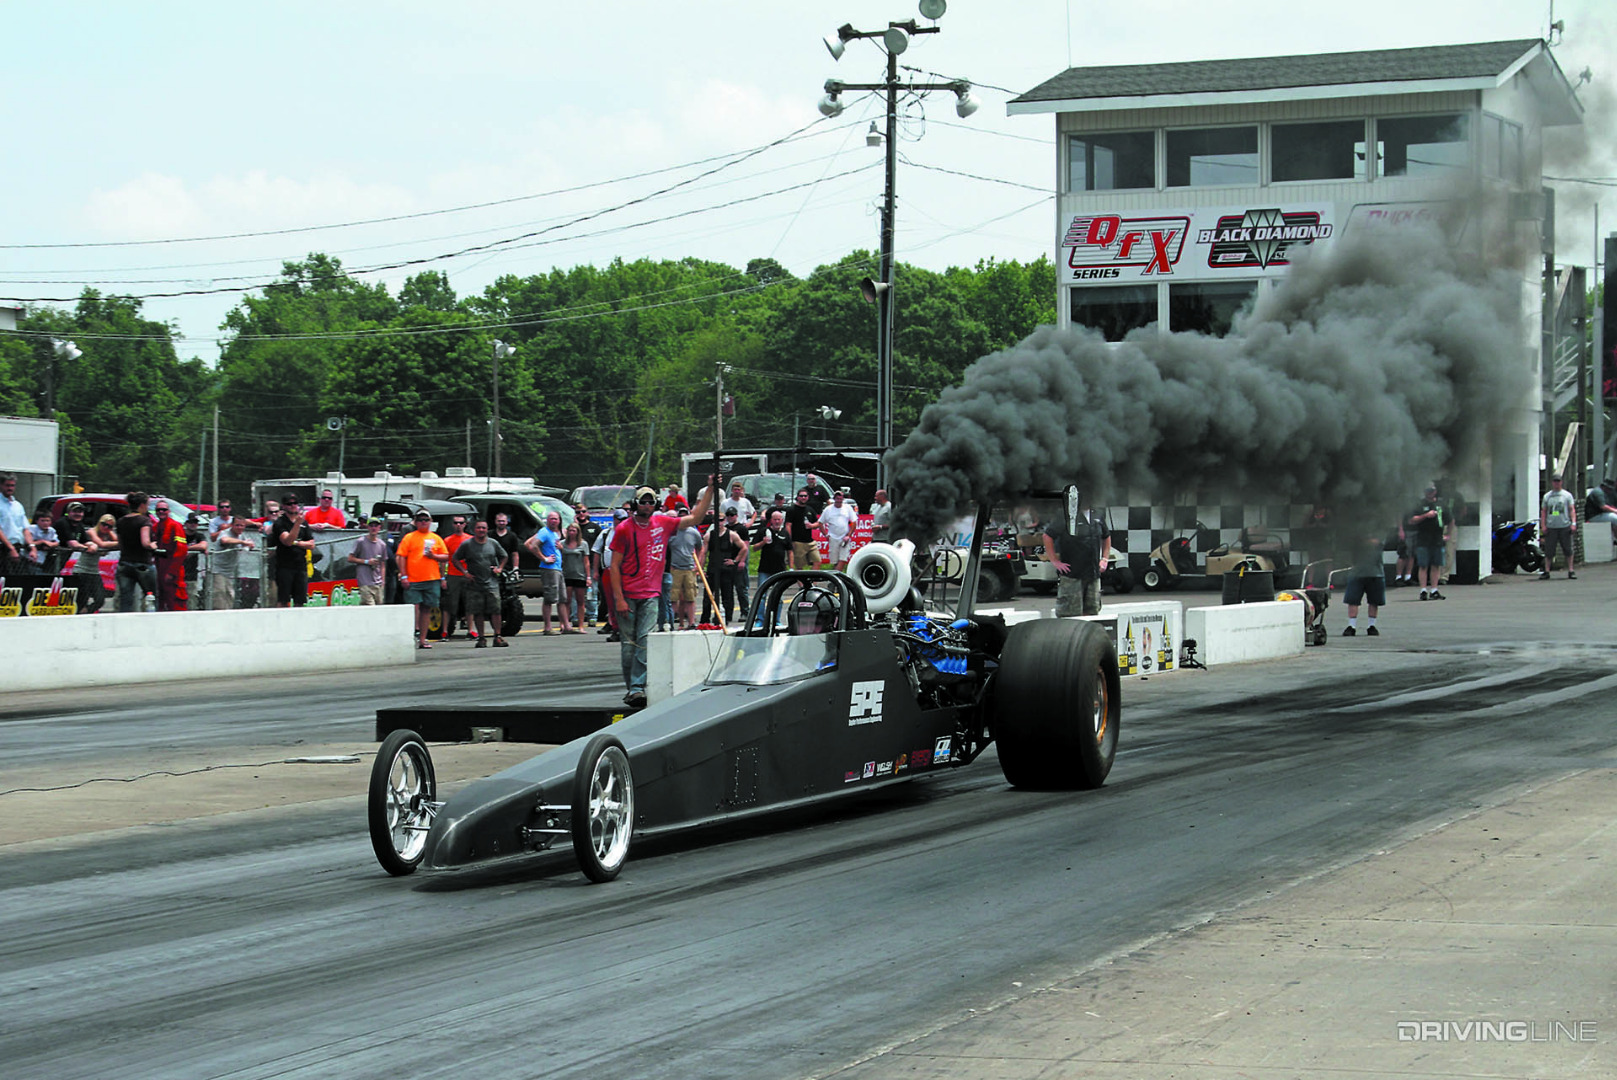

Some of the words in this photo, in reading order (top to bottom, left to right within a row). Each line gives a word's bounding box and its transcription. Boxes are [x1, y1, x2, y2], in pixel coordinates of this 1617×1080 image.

[1198, 228, 1252, 243] BLACK
[1254, 225, 1332, 241] DIAMOND
[1072, 268, 1120, 279] SERIES
[33, 577, 76, 607] DEMON
